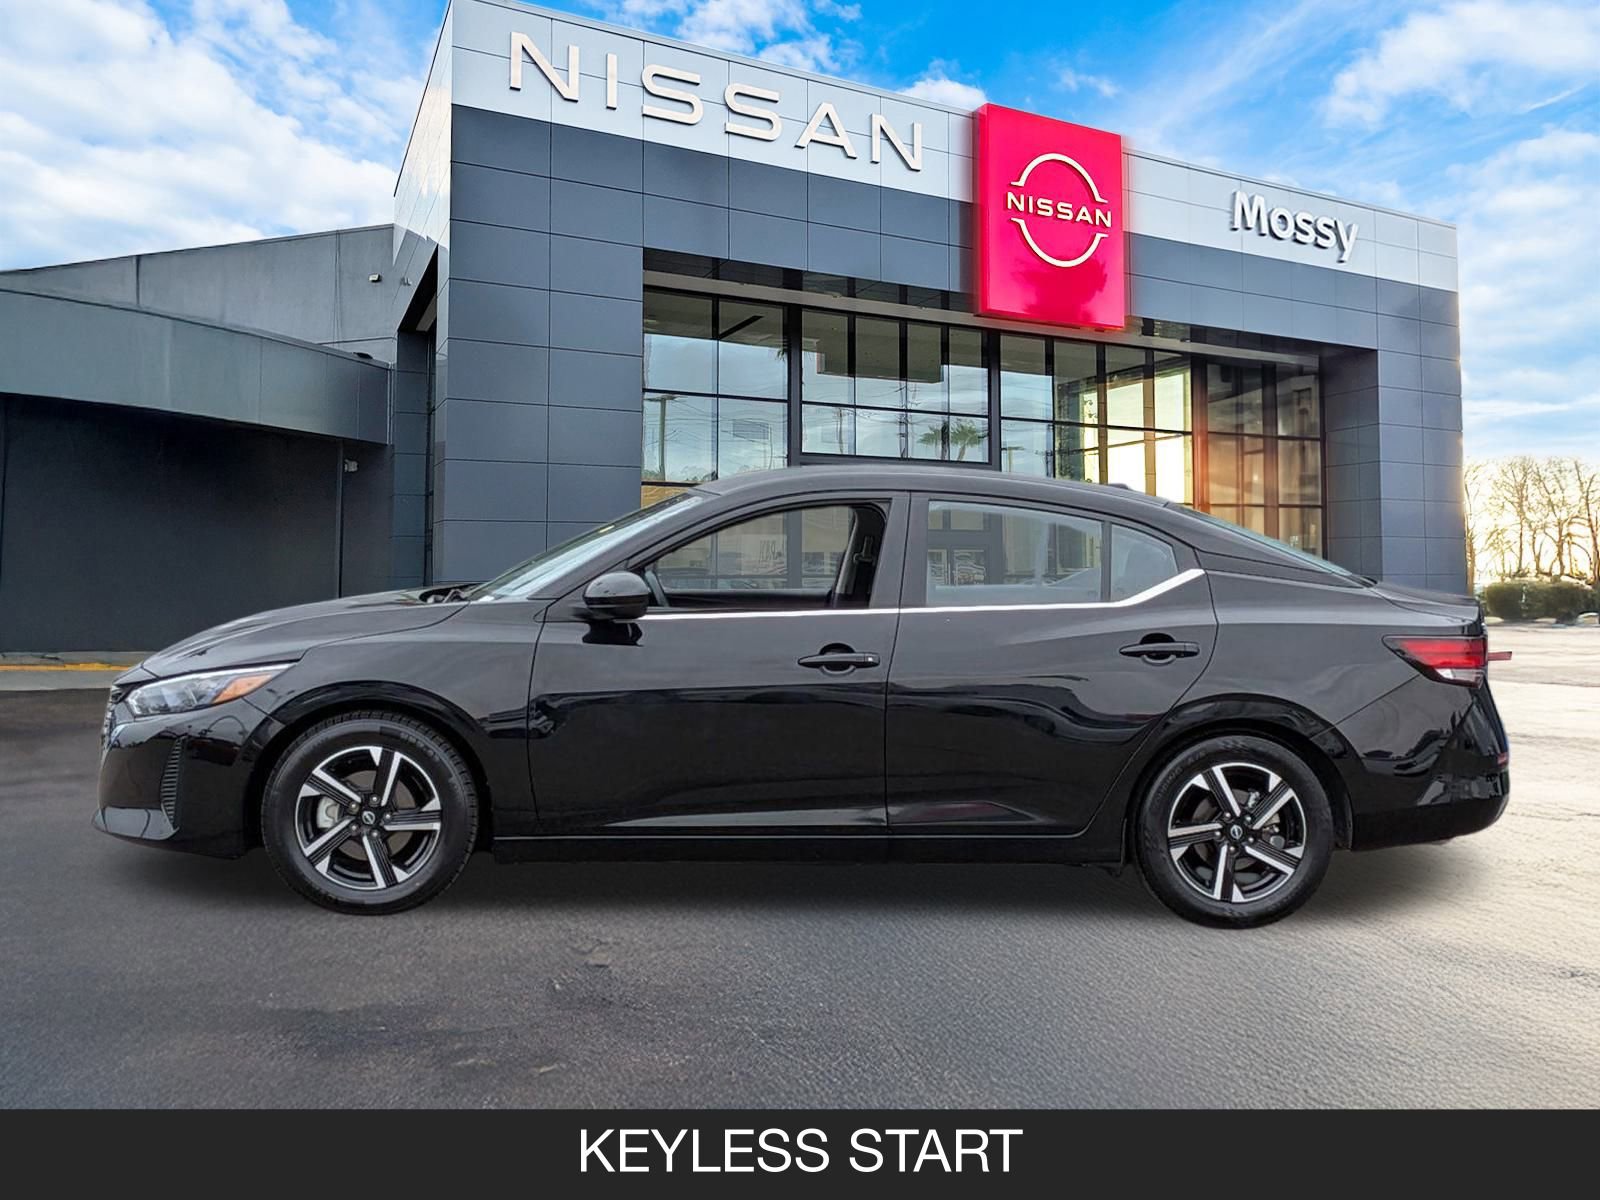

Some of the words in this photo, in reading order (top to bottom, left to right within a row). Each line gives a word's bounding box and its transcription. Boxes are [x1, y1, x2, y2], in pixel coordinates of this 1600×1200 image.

[509, 31, 923, 172] NISSAN
[1006, 191, 1112, 228] NISSAN
[1231, 191, 1359, 263] Mossy
